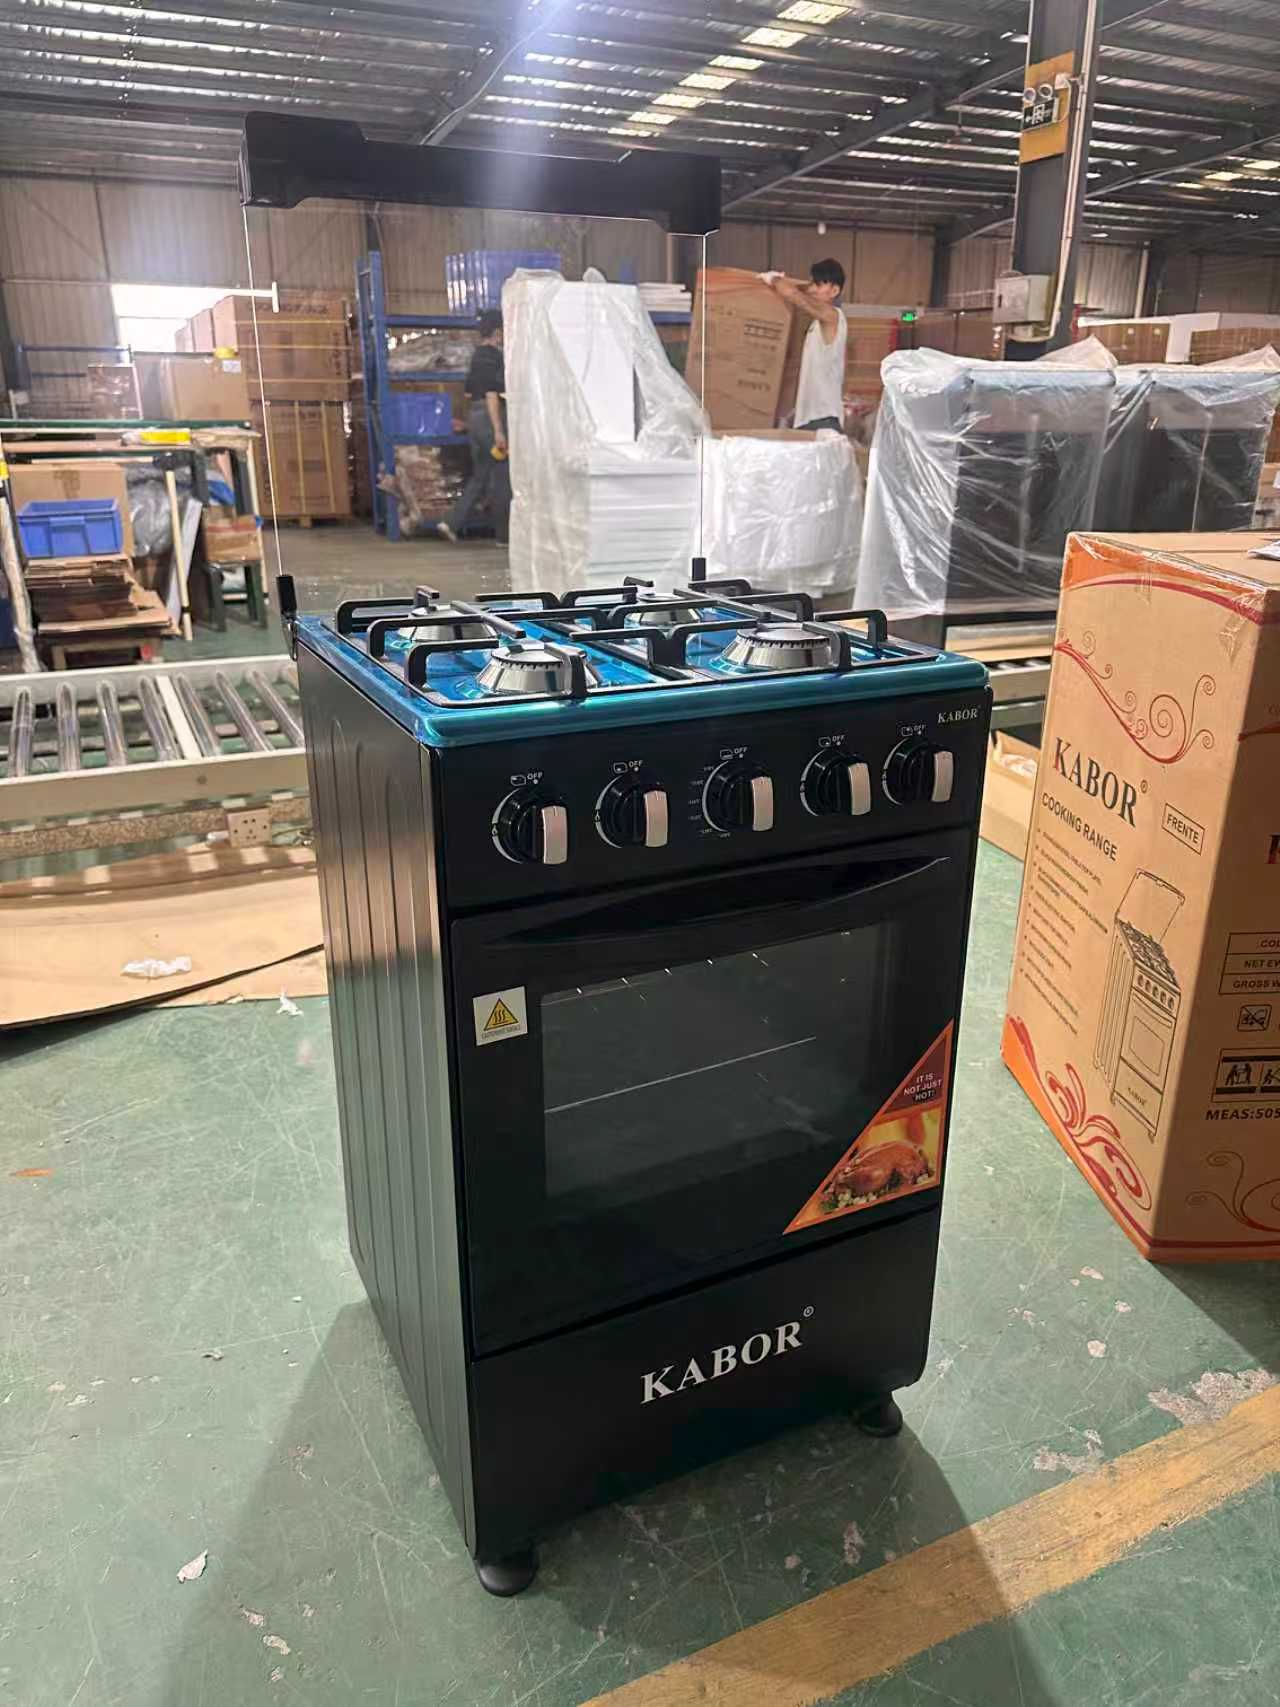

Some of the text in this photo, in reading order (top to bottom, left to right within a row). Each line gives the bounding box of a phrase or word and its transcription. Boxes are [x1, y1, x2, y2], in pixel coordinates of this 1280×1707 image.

[938, 708, 978, 724] KABOR
[831, 734, 846, 742] OFF
[733, 746, 748, 754] OFF
[628, 759, 643, 768] OFF
[526, 771, 543, 781] OFF
[1041, 792, 1083, 833] COOKING
[1082, 823, 1119, 862] RANGE
[1166, 812, 1200, 845] FRENTE
[1233, 979, 1270, 989] GROSS
[904, 1079, 942, 1096] NOT JUST
